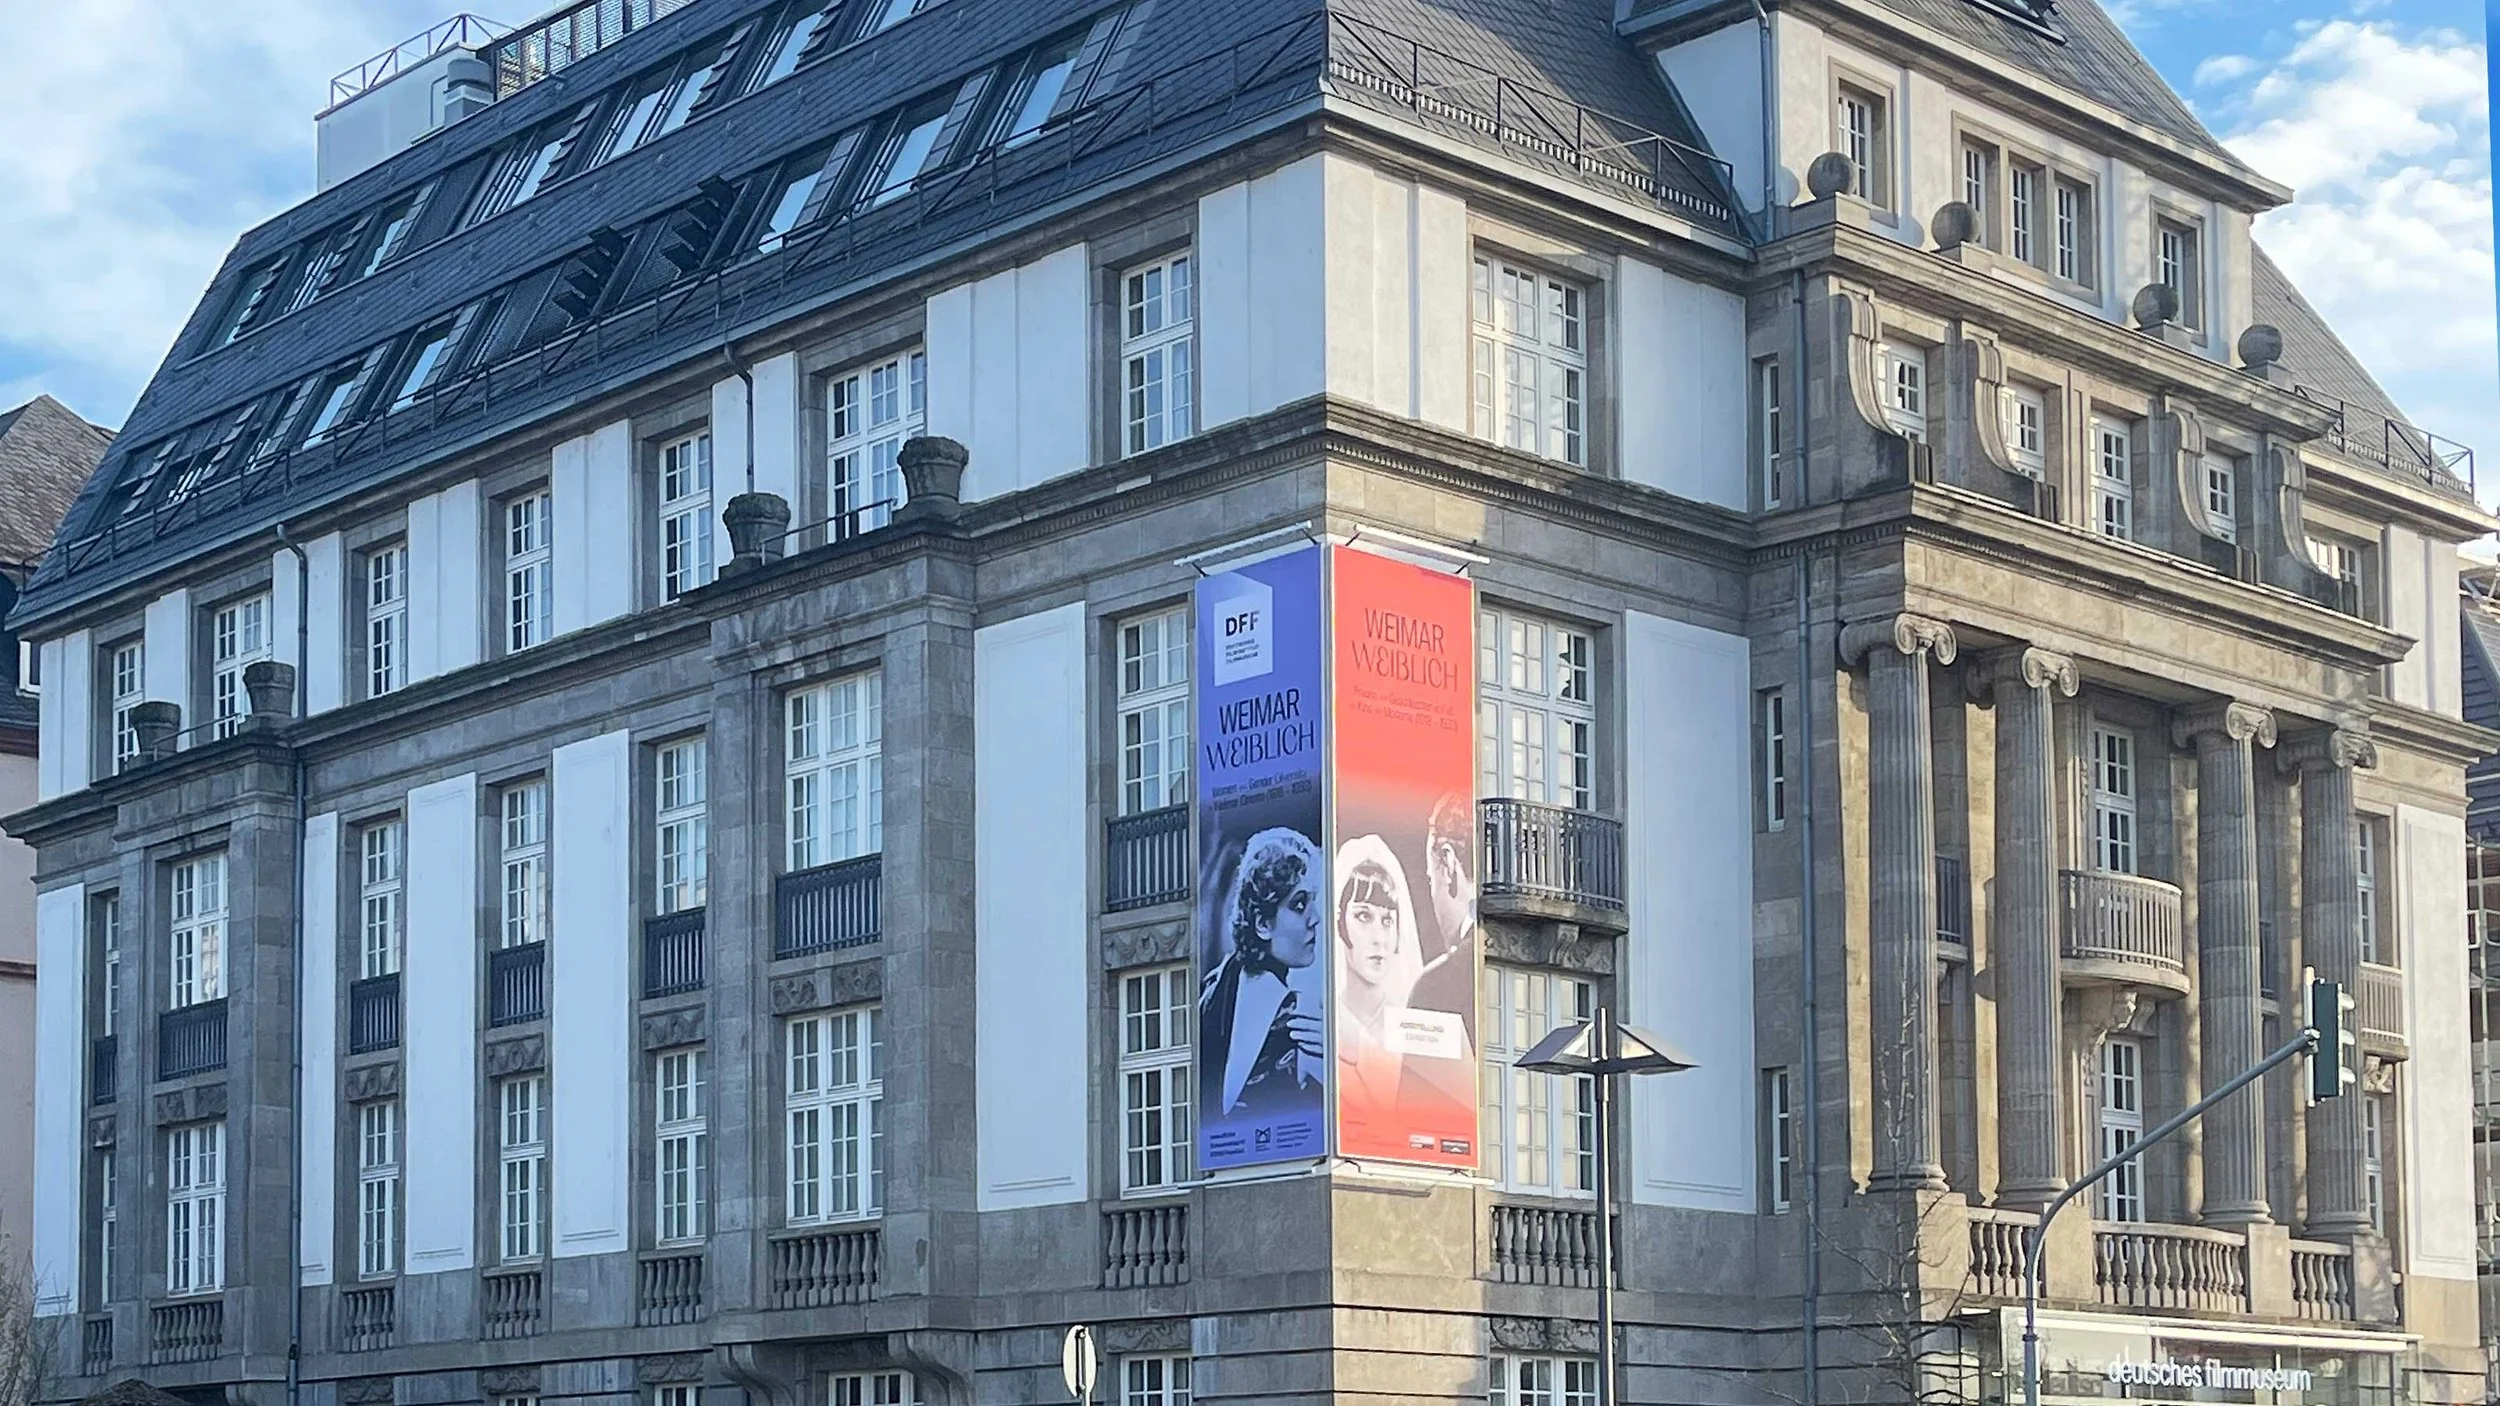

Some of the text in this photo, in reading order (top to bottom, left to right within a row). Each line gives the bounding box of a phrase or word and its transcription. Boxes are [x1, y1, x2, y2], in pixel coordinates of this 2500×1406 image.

[1225, 610, 1260, 637] DFF
[1364, 607, 1444, 656] WEIMAR
[1351, 639, 1458, 692] WEIBLICH
[1219, 688, 1300, 735] WEIMAR
[1206, 720, 1315, 772] WEIBLICH
[2109, 1353, 2312, 1391] deutsches filmmuseum
